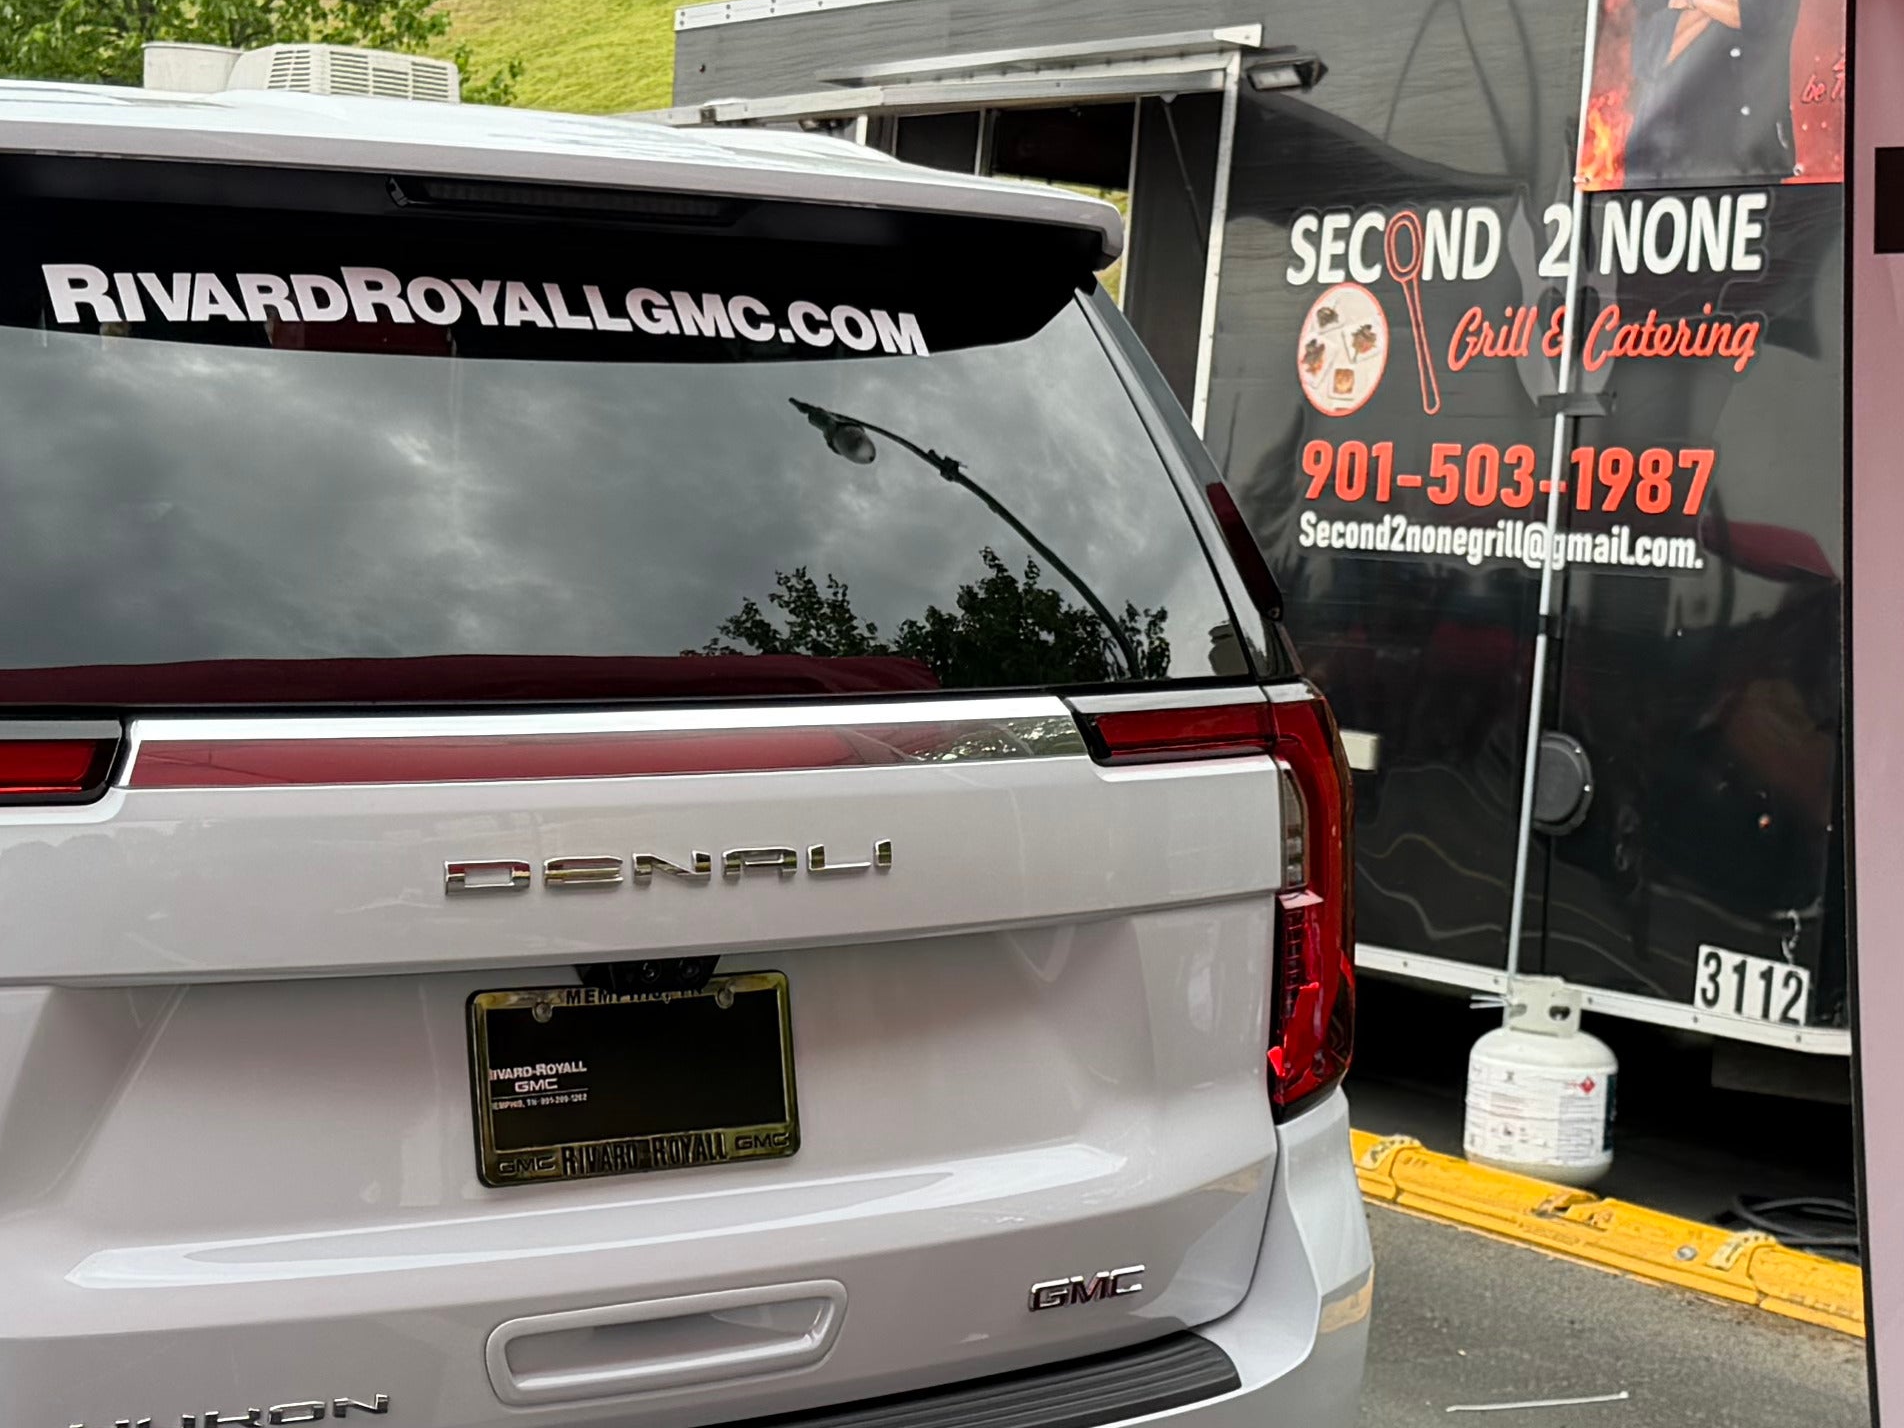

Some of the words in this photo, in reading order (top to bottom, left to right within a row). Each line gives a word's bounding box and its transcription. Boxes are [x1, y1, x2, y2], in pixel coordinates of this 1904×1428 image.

[1286, 207, 1502, 285] SECOND
[1538, 203, 1575, 277] 2
[1599, 192, 1768, 276] NONE
[40, 263, 930, 356] RIVARDROYALLGMC.COM
[1447, 305, 1538, 372] Grill
[1542, 306, 1567, 358] &
[1582, 303, 1761, 372] Catering
[1301, 439, 1715, 515] 901-503-1987
[444, 840, 892, 896] DENALI
[1701, 951, 1803, 1026] 3112
[515, 1078, 558, 1092] GMC
[498, 1156, 556, 1174] GMC
[735, 1132, 790, 1150] GMC
[1028, 1264, 1145, 1312] GMC
